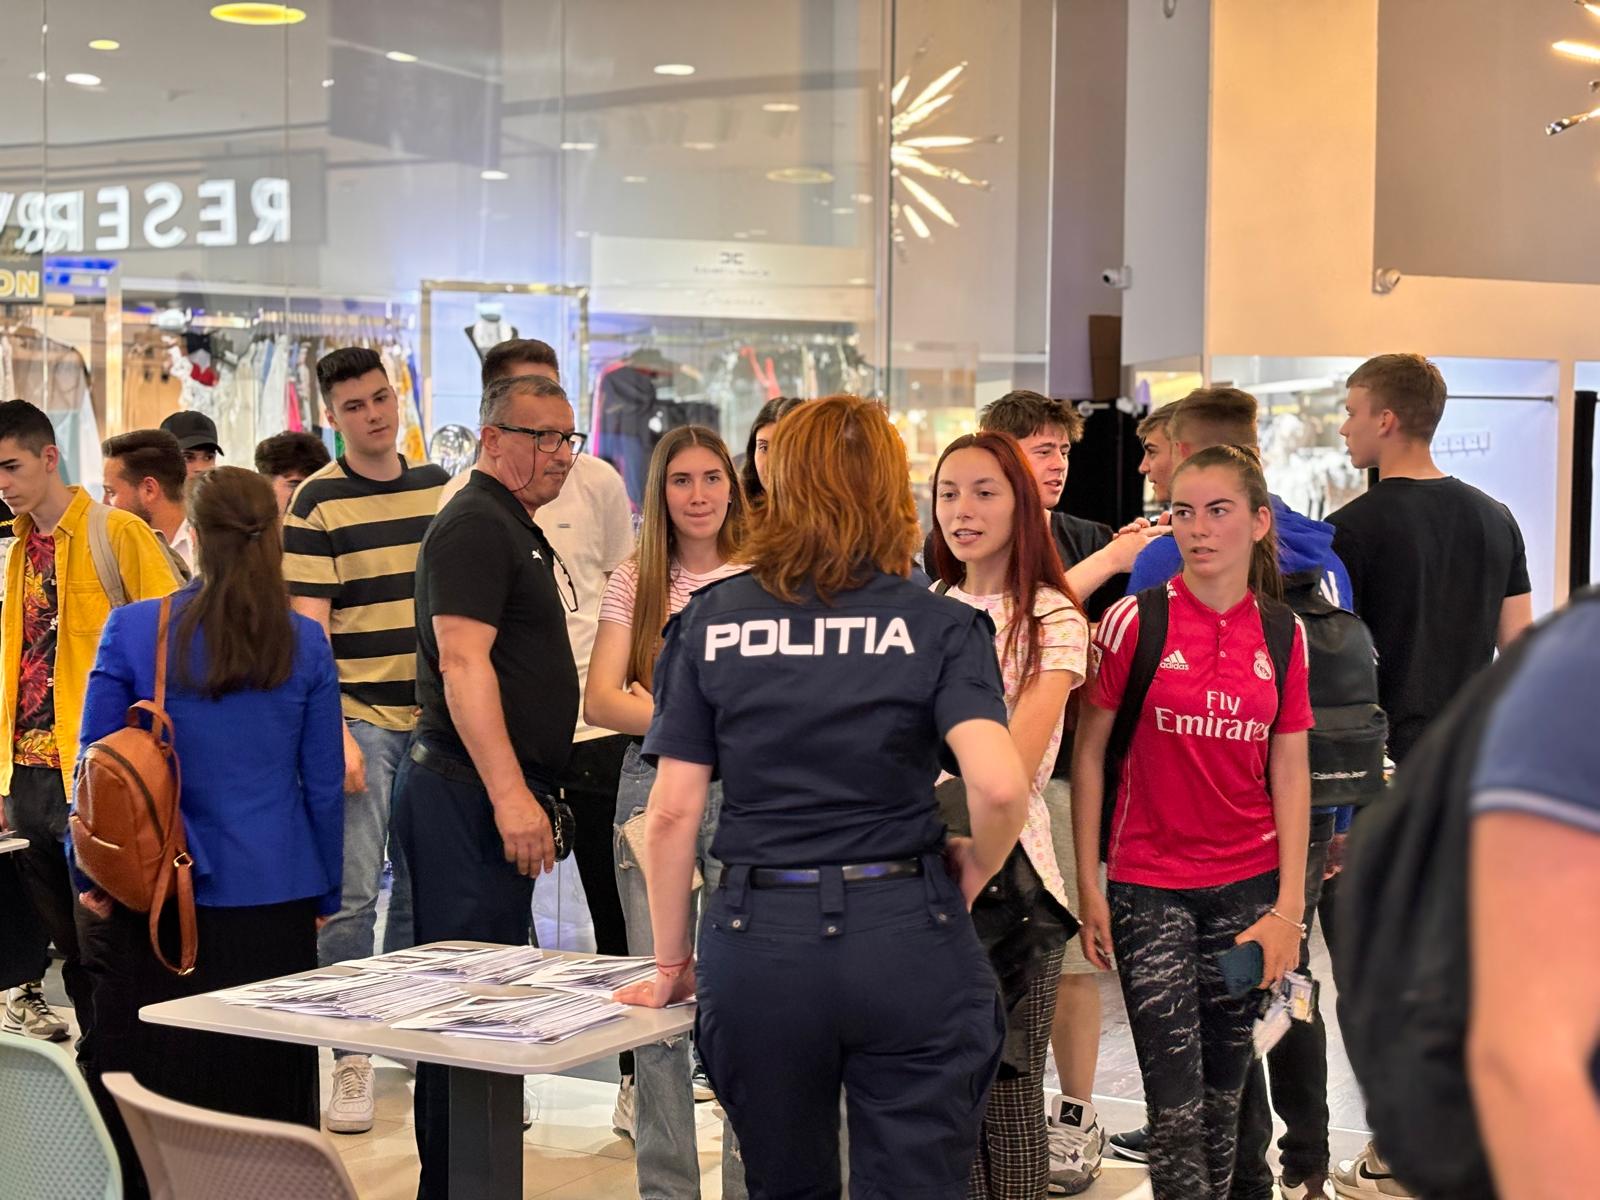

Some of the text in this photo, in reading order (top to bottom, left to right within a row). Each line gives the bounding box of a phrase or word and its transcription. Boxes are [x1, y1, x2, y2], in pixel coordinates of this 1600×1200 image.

[704, 617, 915, 662] POLITIA
[1159, 661, 1189, 671] adidas
[1206, 690, 1241, 715] Fly
